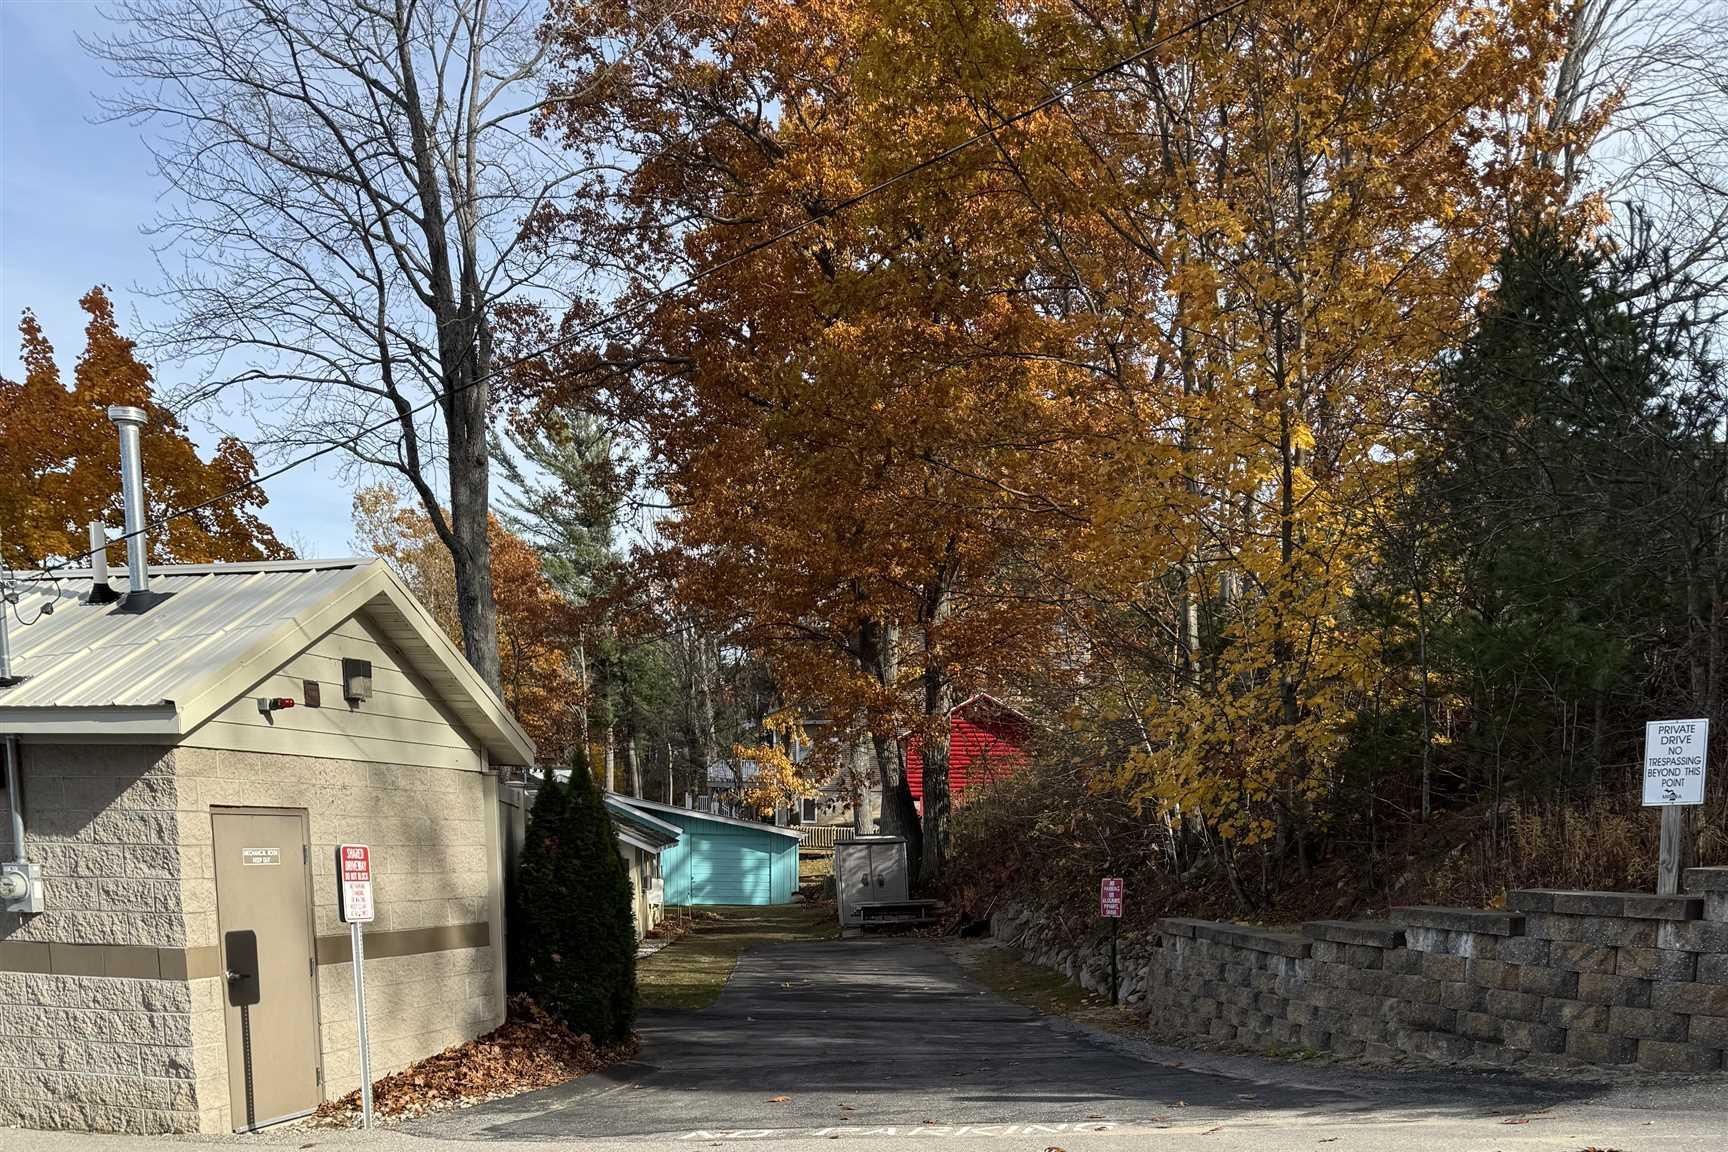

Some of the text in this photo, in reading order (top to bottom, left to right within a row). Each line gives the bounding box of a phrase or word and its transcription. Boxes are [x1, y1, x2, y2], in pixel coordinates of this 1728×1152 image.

[1658, 725, 1695, 734] PRIVATE
[1661, 735, 1692, 745] DRIVE
[1668, 746, 1682, 755] NO
[1648, 756, 1701, 766] TRESPASSING
[1648, 767, 1700, 777] BEYOND THIS
[1662, 778, 1685, 787] POINT
[677, 1122, 1121, 1139] NO PARKING
